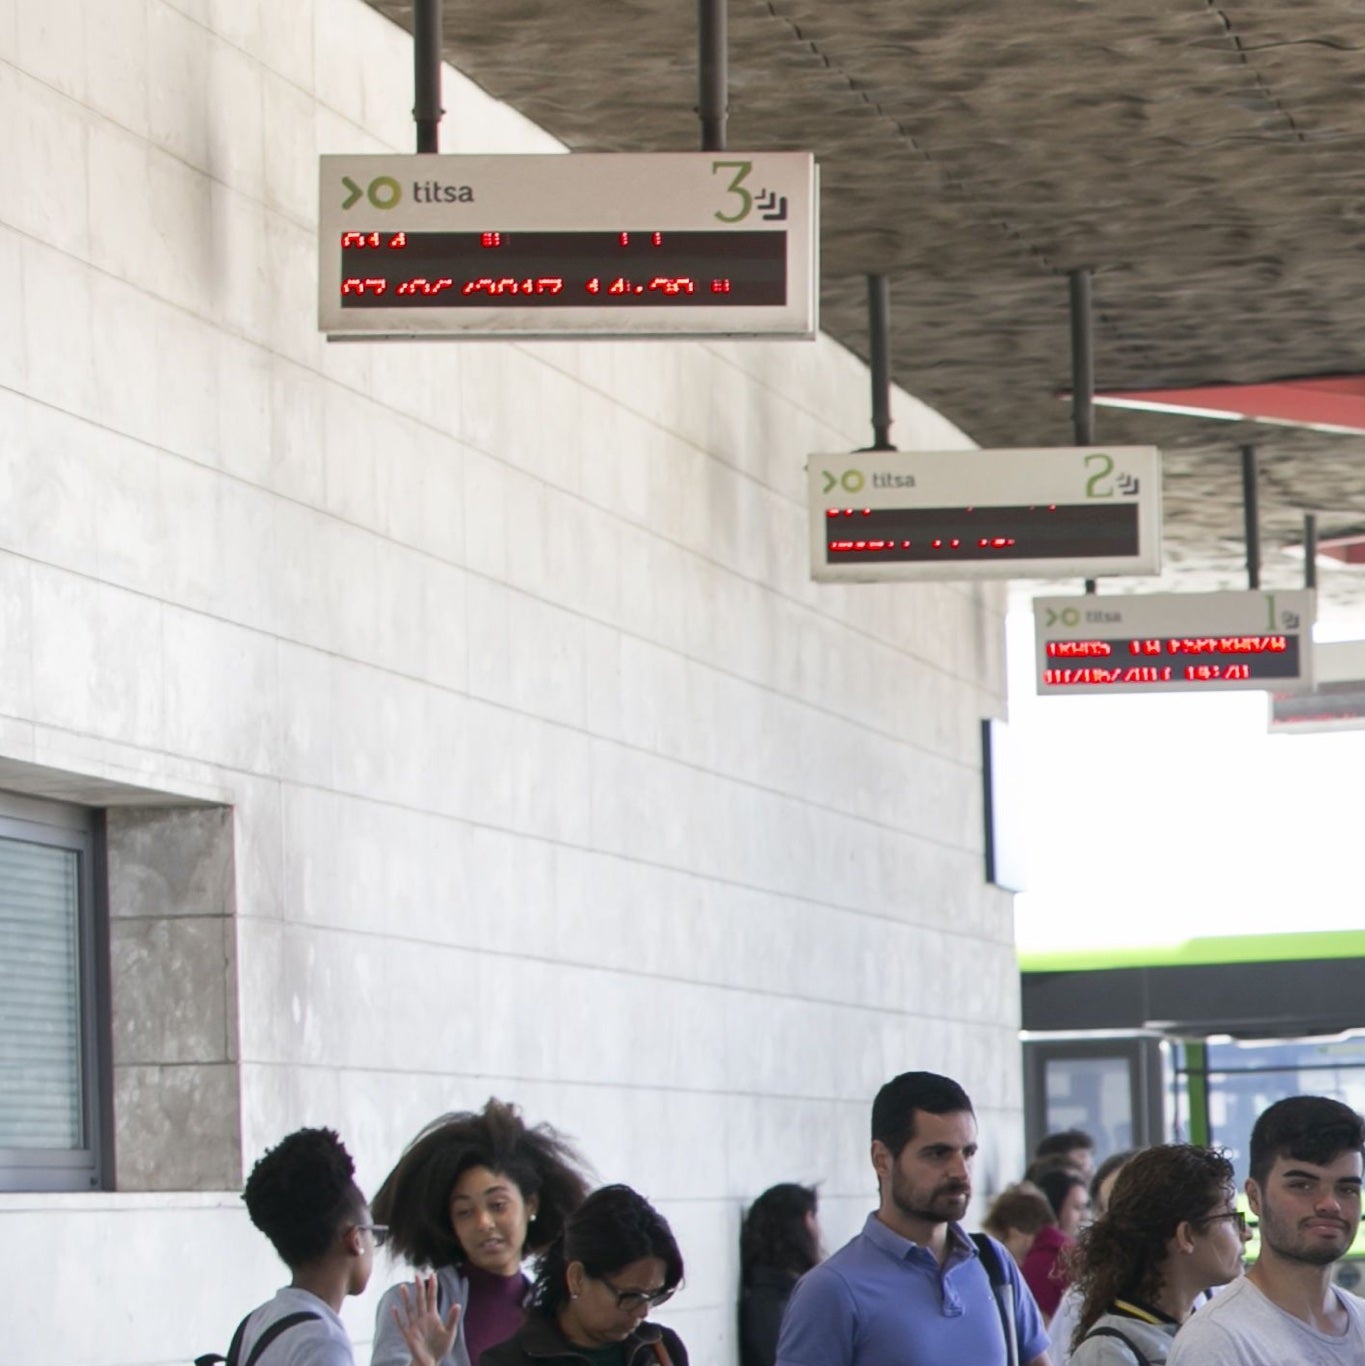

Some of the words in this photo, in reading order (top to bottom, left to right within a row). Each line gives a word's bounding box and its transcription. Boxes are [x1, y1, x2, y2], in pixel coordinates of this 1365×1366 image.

[413, 181, 475, 203] titsa
[712, 161, 753, 224] 3
[872, 472, 916, 490] titsa
[1084, 453, 1115, 498] 2
[1265, 594, 1276, 630] 1
